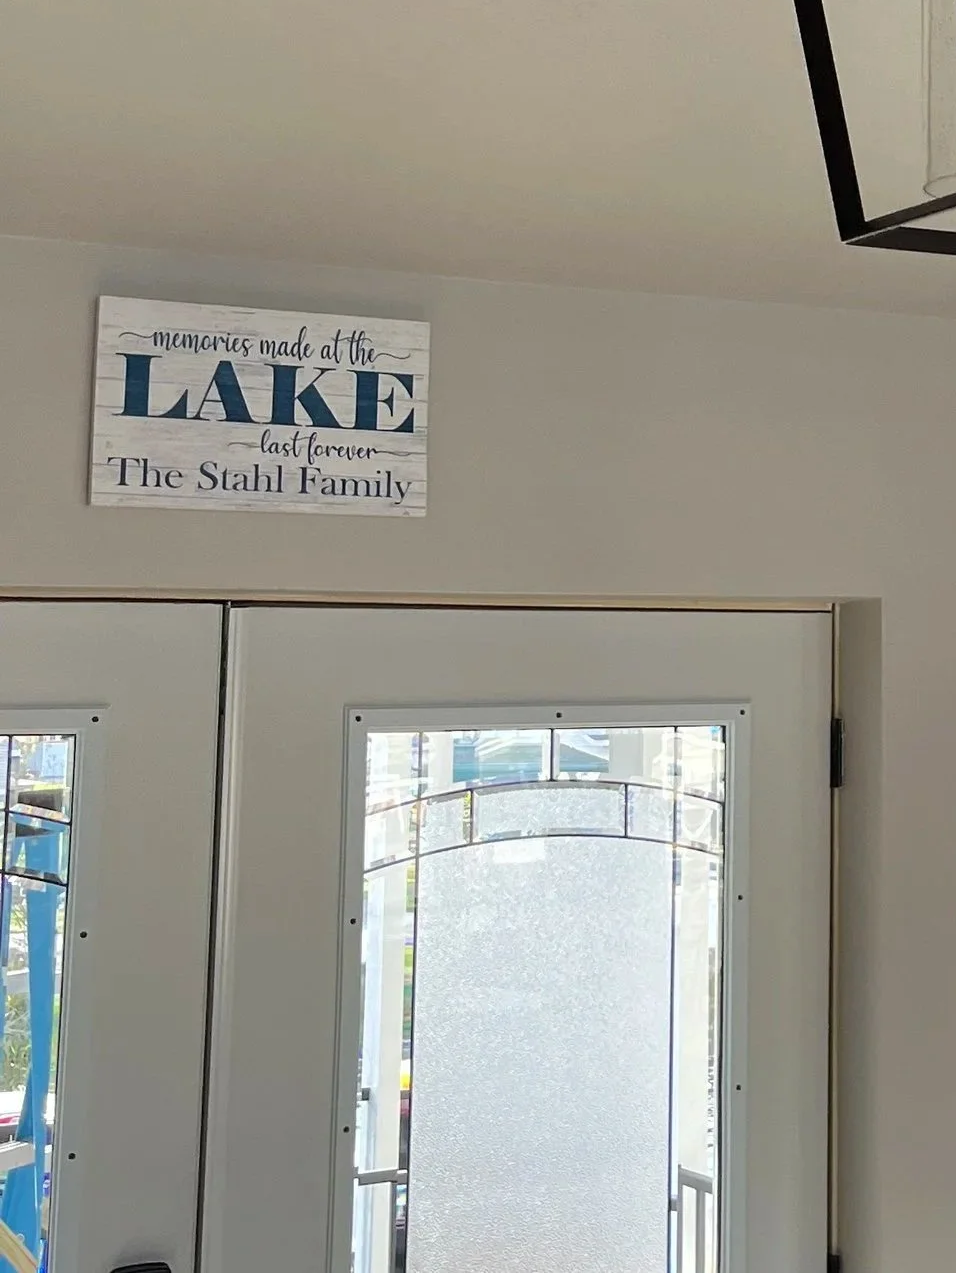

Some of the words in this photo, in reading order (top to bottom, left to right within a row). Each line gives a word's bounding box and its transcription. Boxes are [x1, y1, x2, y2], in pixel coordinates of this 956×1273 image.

[150, 330, 252, 358] memories
[259, 326, 314, 359] made
[320, 329, 343, 363] at
[112, 352, 415, 434] LAKE
[259, 428, 301, 458] last
[304, 431, 379, 465] forever
[107, 456, 184, 489] The
[197, 460, 283, 494] Stahl
[299, 467, 412, 505] Family
